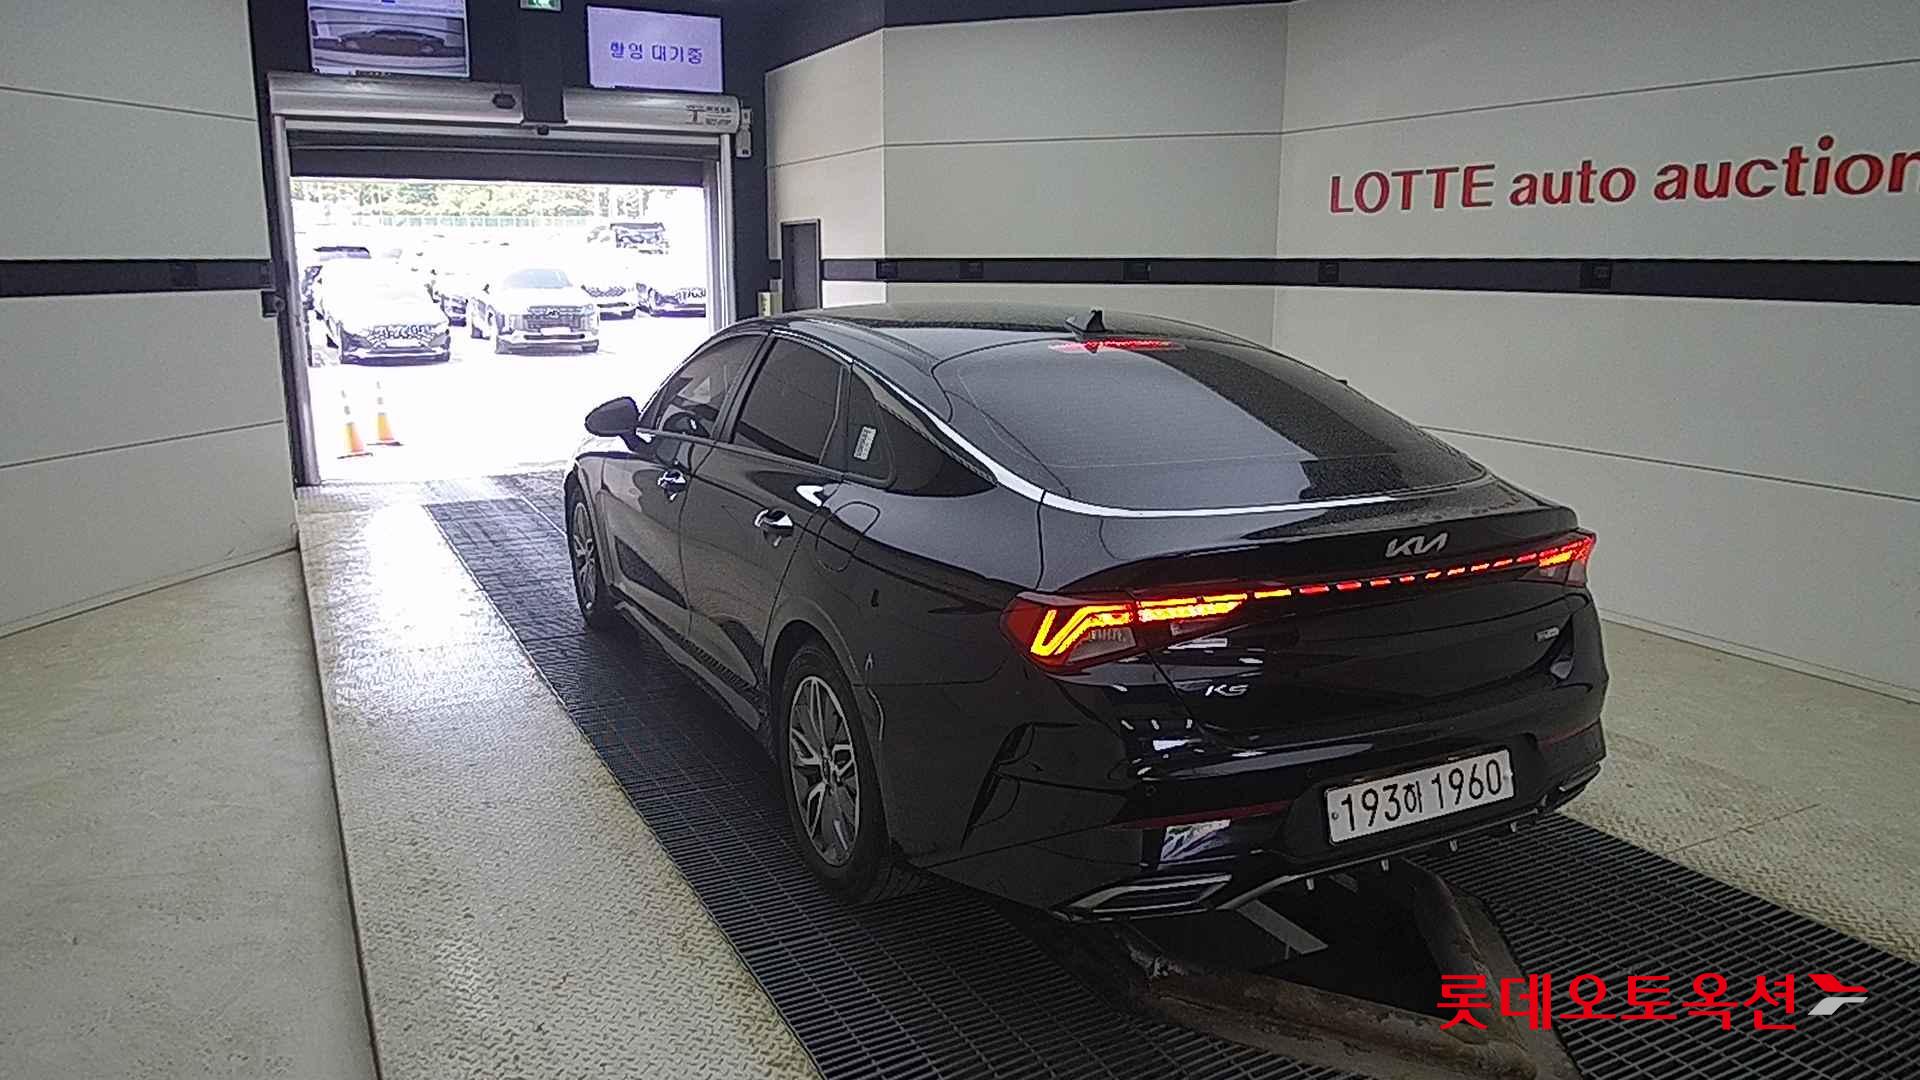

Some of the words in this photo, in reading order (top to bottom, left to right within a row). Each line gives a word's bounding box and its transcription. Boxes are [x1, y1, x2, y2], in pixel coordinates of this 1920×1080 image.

[651, 44, 703, 65] 대기중
[1329, 163, 1496, 214] LOTTE
[1509, 159, 1637, 206] auto
[1431, 759, 1502, 809] 1960
